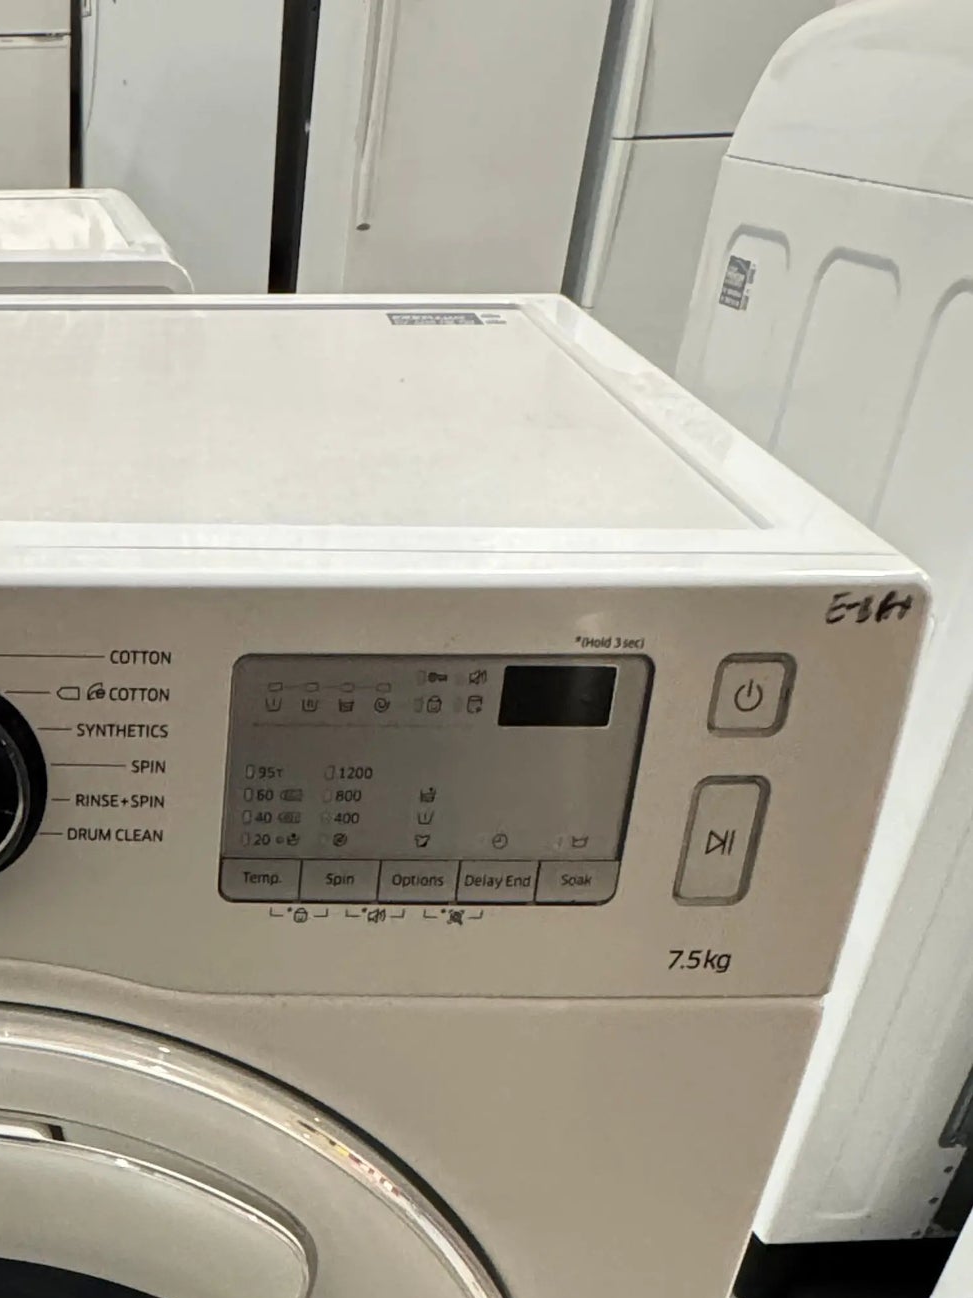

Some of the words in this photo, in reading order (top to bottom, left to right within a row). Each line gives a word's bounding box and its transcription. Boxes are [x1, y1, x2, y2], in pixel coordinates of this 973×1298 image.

[614, 637, 622, 649] 3
[109, 650, 172, 665] COTTON
[109, 687, 170, 702] COTTON
[77, 723, 169, 738] SYNTHETICS
[131, 759, 166, 774] SPIN
[339, 767, 373, 780] 1200
[75, 793, 165, 809] RINSE+SPIN
[335, 789, 362, 802] 800
[333, 811, 360, 825] 400
[67, 826, 111, 842] DRUM
[115, 828, 164, 843] CLEAN
[243, 871, 282, 887] Temp.
[325, 872, 355, 887] Spin
[391, 873, 444, 888] Options
[464, 874, 503, 889] Delay
[505, 874, 531, 888] End
[560, 873, 592, 887] Soak
